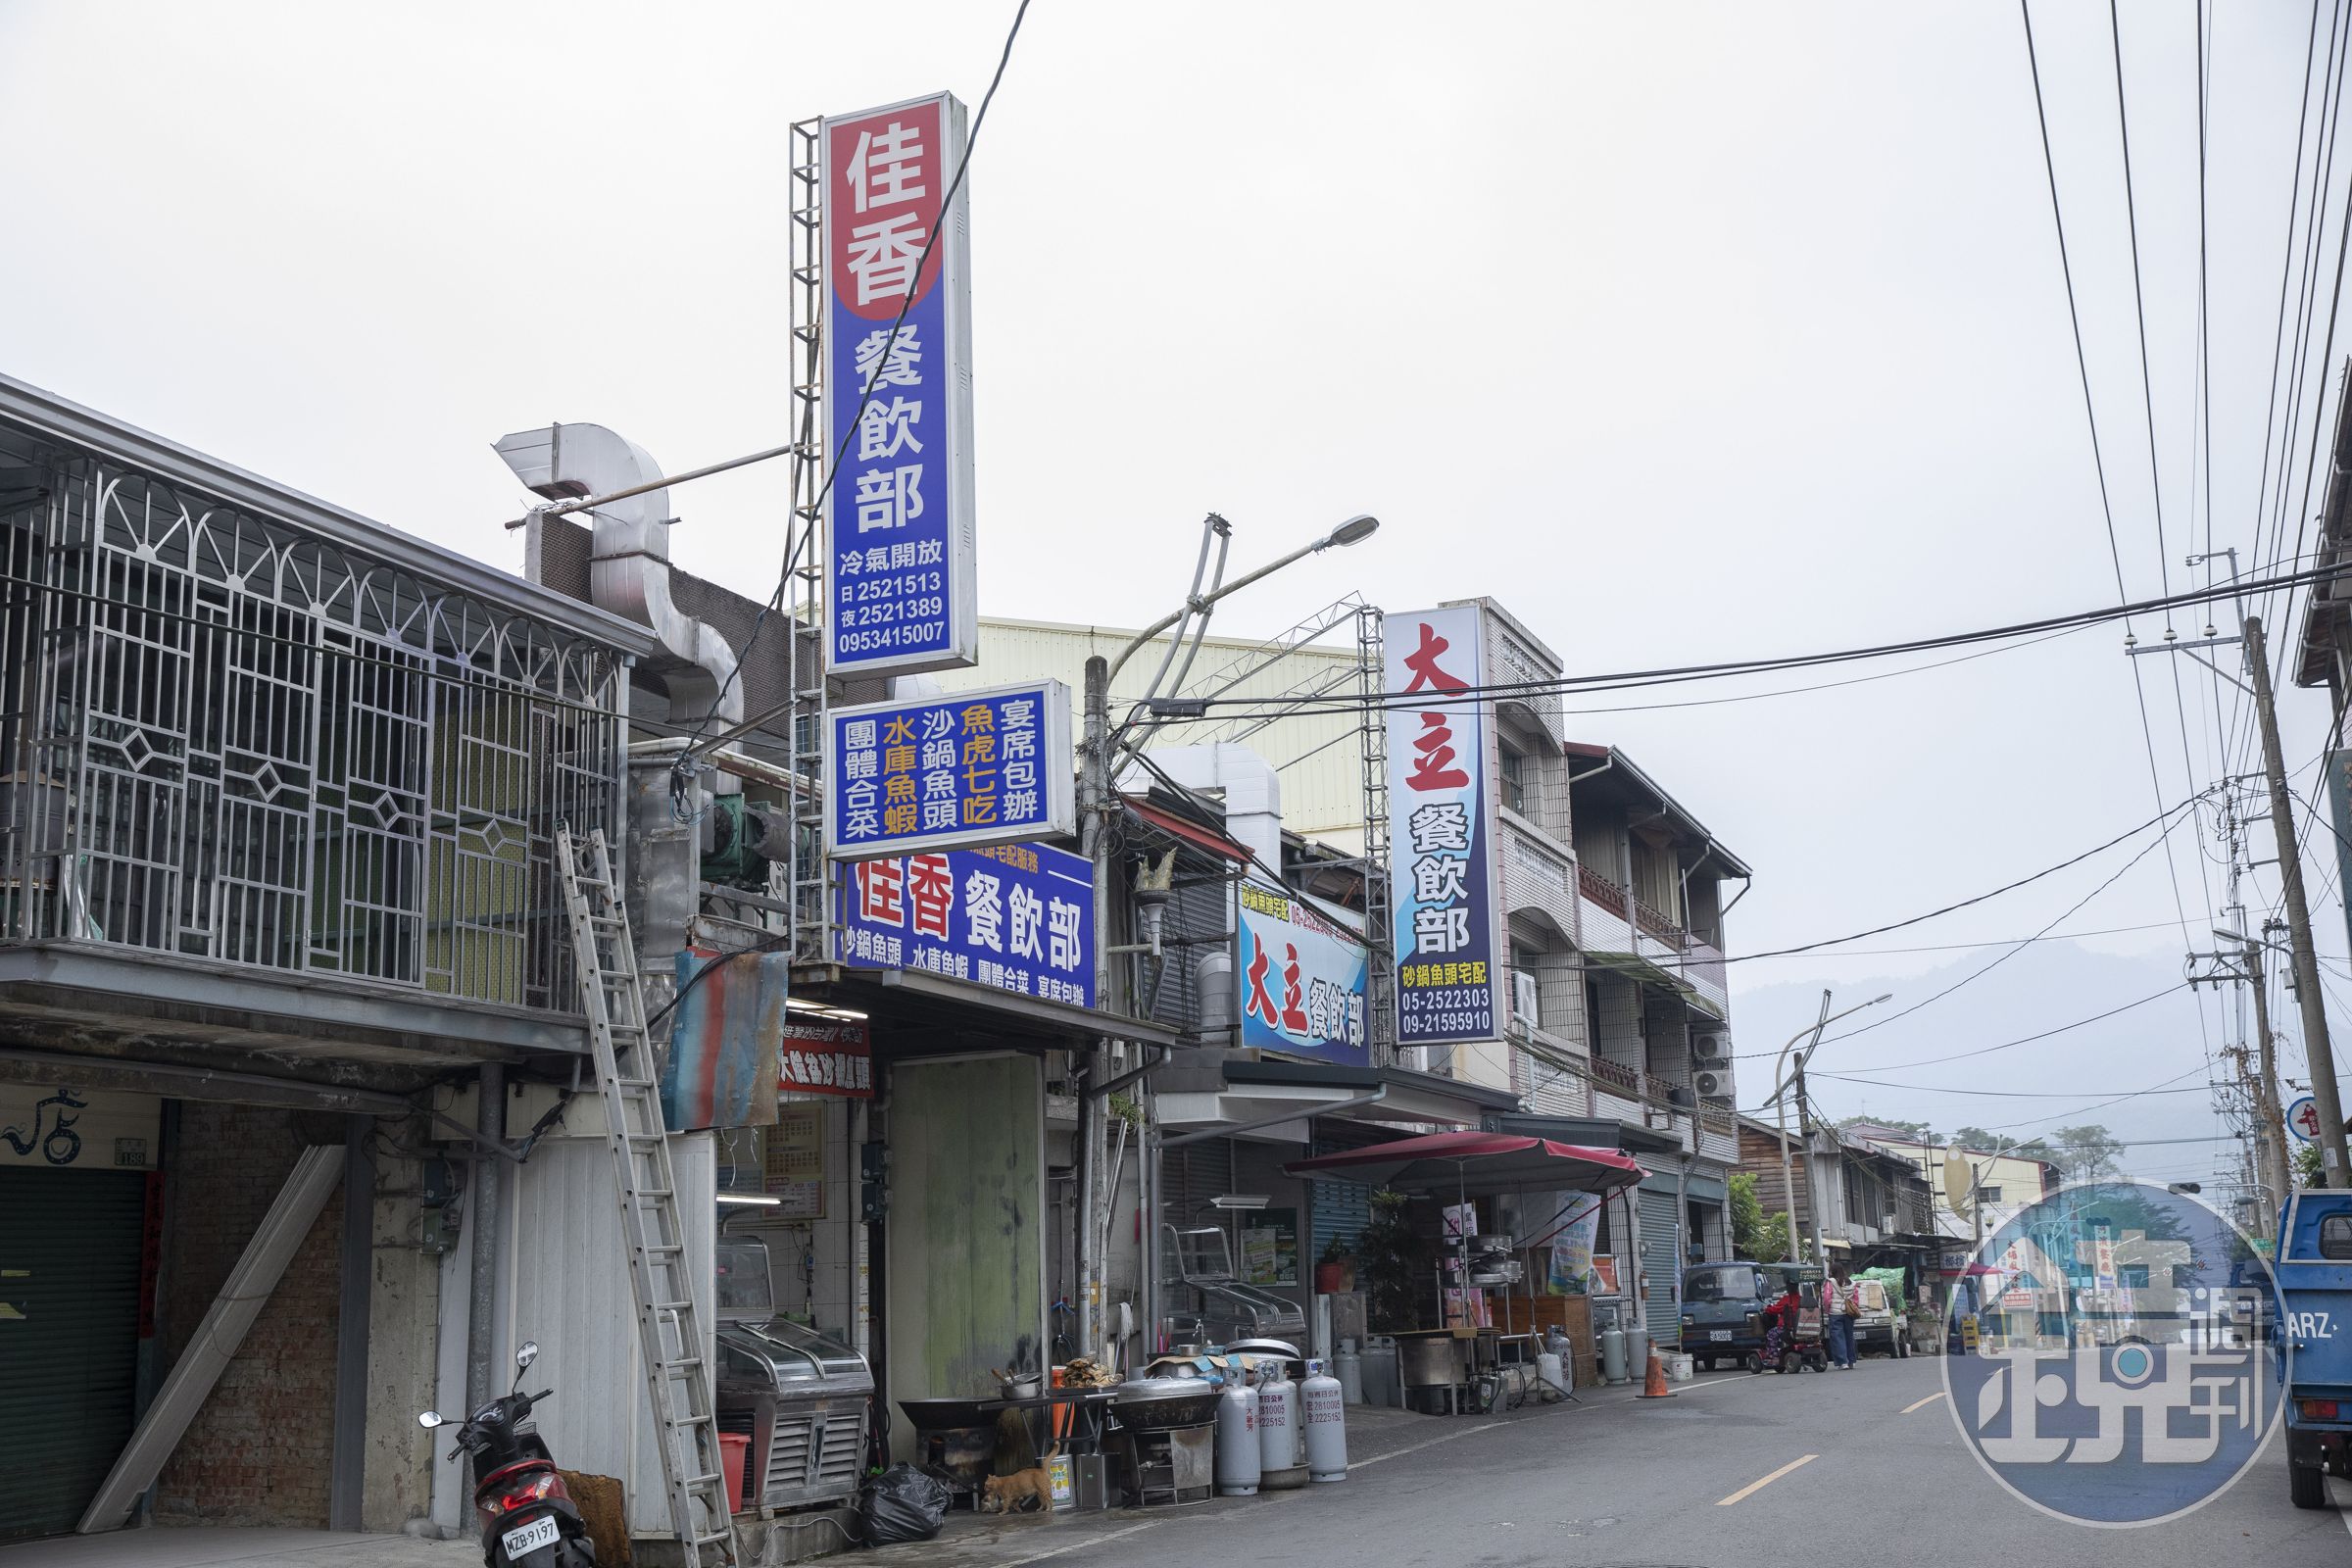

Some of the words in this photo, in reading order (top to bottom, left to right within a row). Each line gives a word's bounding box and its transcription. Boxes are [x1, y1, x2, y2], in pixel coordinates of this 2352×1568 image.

[847, 122, 926, 307] 佳香
[855, 324, 925, 534] 餐飲部
[839, 539, 943, 576] 冷氣開放
[839, 620, 945, 654] 0953415007
[960, 705, 998, 825] 魚虎七吃
[1000, 699, 1039, 822] 宴席包辦
[1402, 622, 1471, 792] 大立
[845, 719, 879, 839] 團體合菜
[883, 715, 918, 835] 水庫魚蝦
[921, 709, 958, 831] 沙鍋魚頭
[855, 851, 955, 943] 佳香
[964, 869, 1082, 973] 餐飲部
[1409, 803, 1470, 955] 餐飲部
[1246, 932, 1309, 1038] 大立
[1309, 977, 1365, 1049] 餐飲部
[1401, 961, 1487, 988] 砂鍋魚頭宅配
[1402, 988, 1489, 1011] 05-2522303
[1402, 1010, 1490, 1033] 09-21595910
